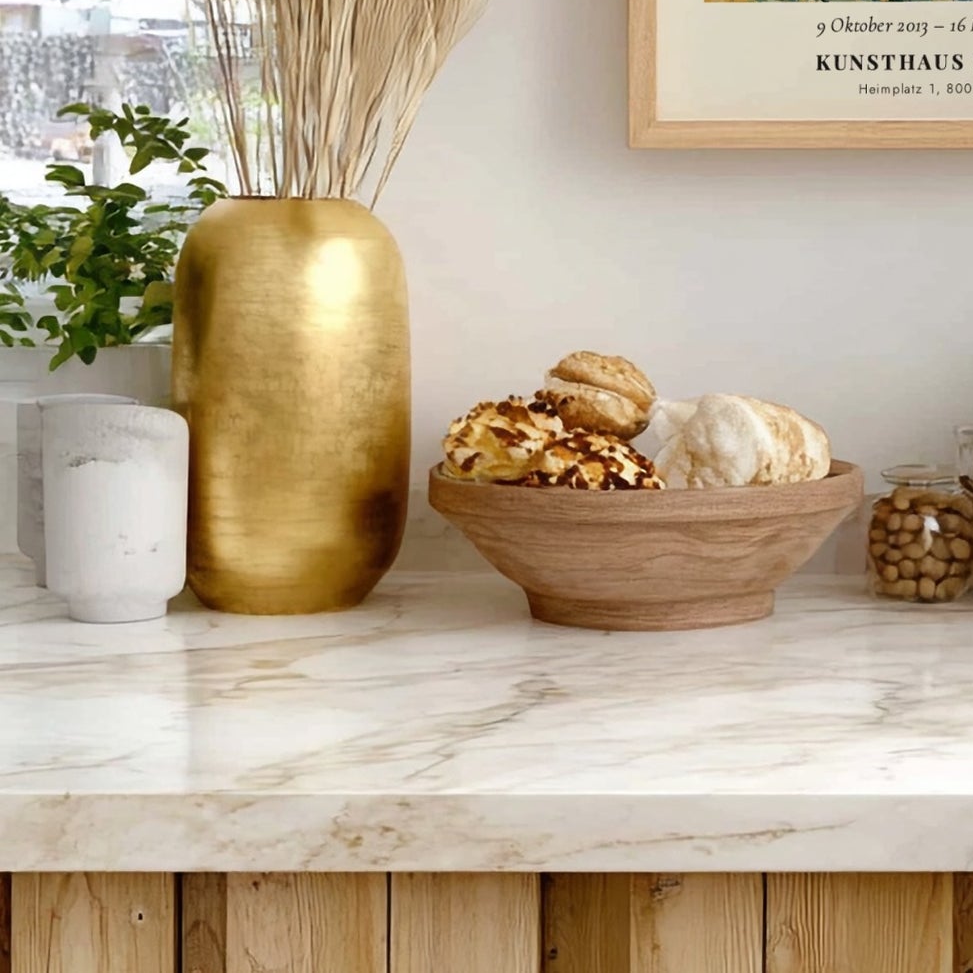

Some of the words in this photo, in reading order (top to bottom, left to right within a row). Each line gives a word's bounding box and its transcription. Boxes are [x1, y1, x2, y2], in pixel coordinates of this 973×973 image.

[816, 22, 826, 38] 9
[830, 16, 893, 33] Oktober
[897, 21, 928, 38] 2013
[950, 17, 966, 33] 16
[816, 53, 964, 72] KUNSTHAUS
[858, 82, 923, 97] Heimplatz
[929, 83, 940, 96] 1,
